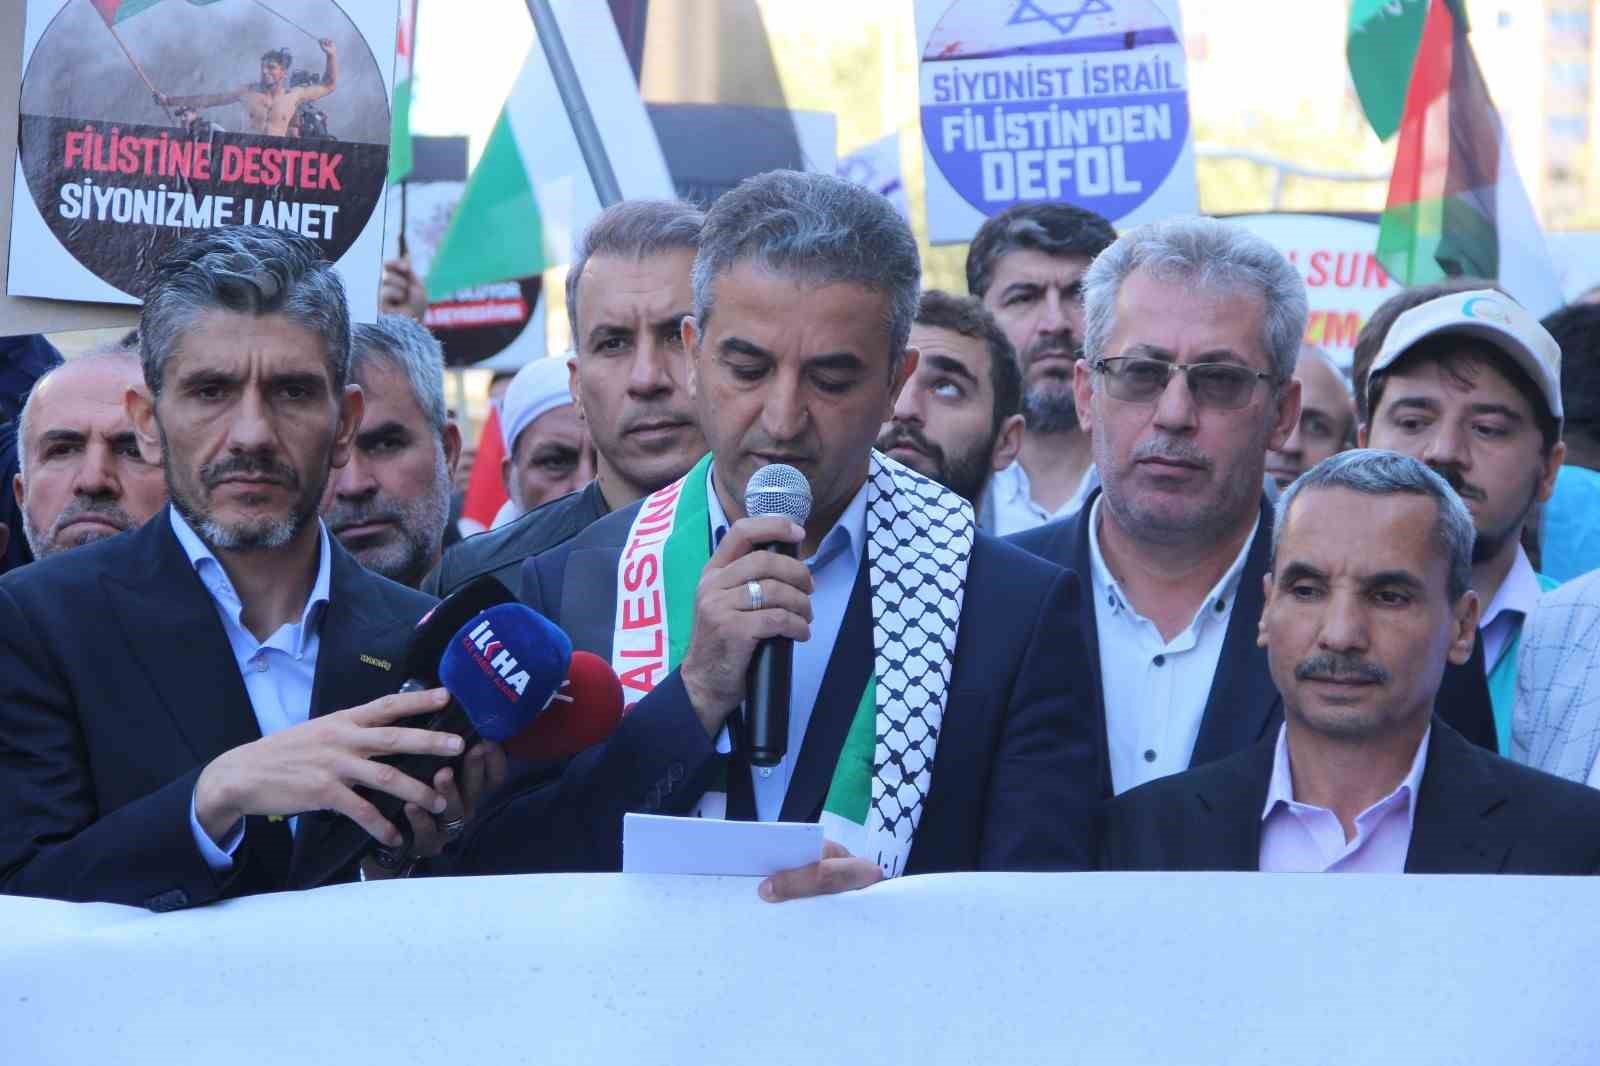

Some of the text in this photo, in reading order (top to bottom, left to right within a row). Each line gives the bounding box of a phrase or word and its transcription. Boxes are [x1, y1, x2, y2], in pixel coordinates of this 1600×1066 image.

[933, 55, 1182, 102] SİYONİST İSRAİL
[942, 103, 1172, 152] FİLİSTİN'DEN
[63, 122, 344, 192] FİLİSTİNE DESTEK
[981, 145, 1143, 202] DEFOL
[59, 177, 235, 230] SİYONİZME
[1289, 250, 1388, 288] SUN
[618, 480, 684, 717] ALESTIN
